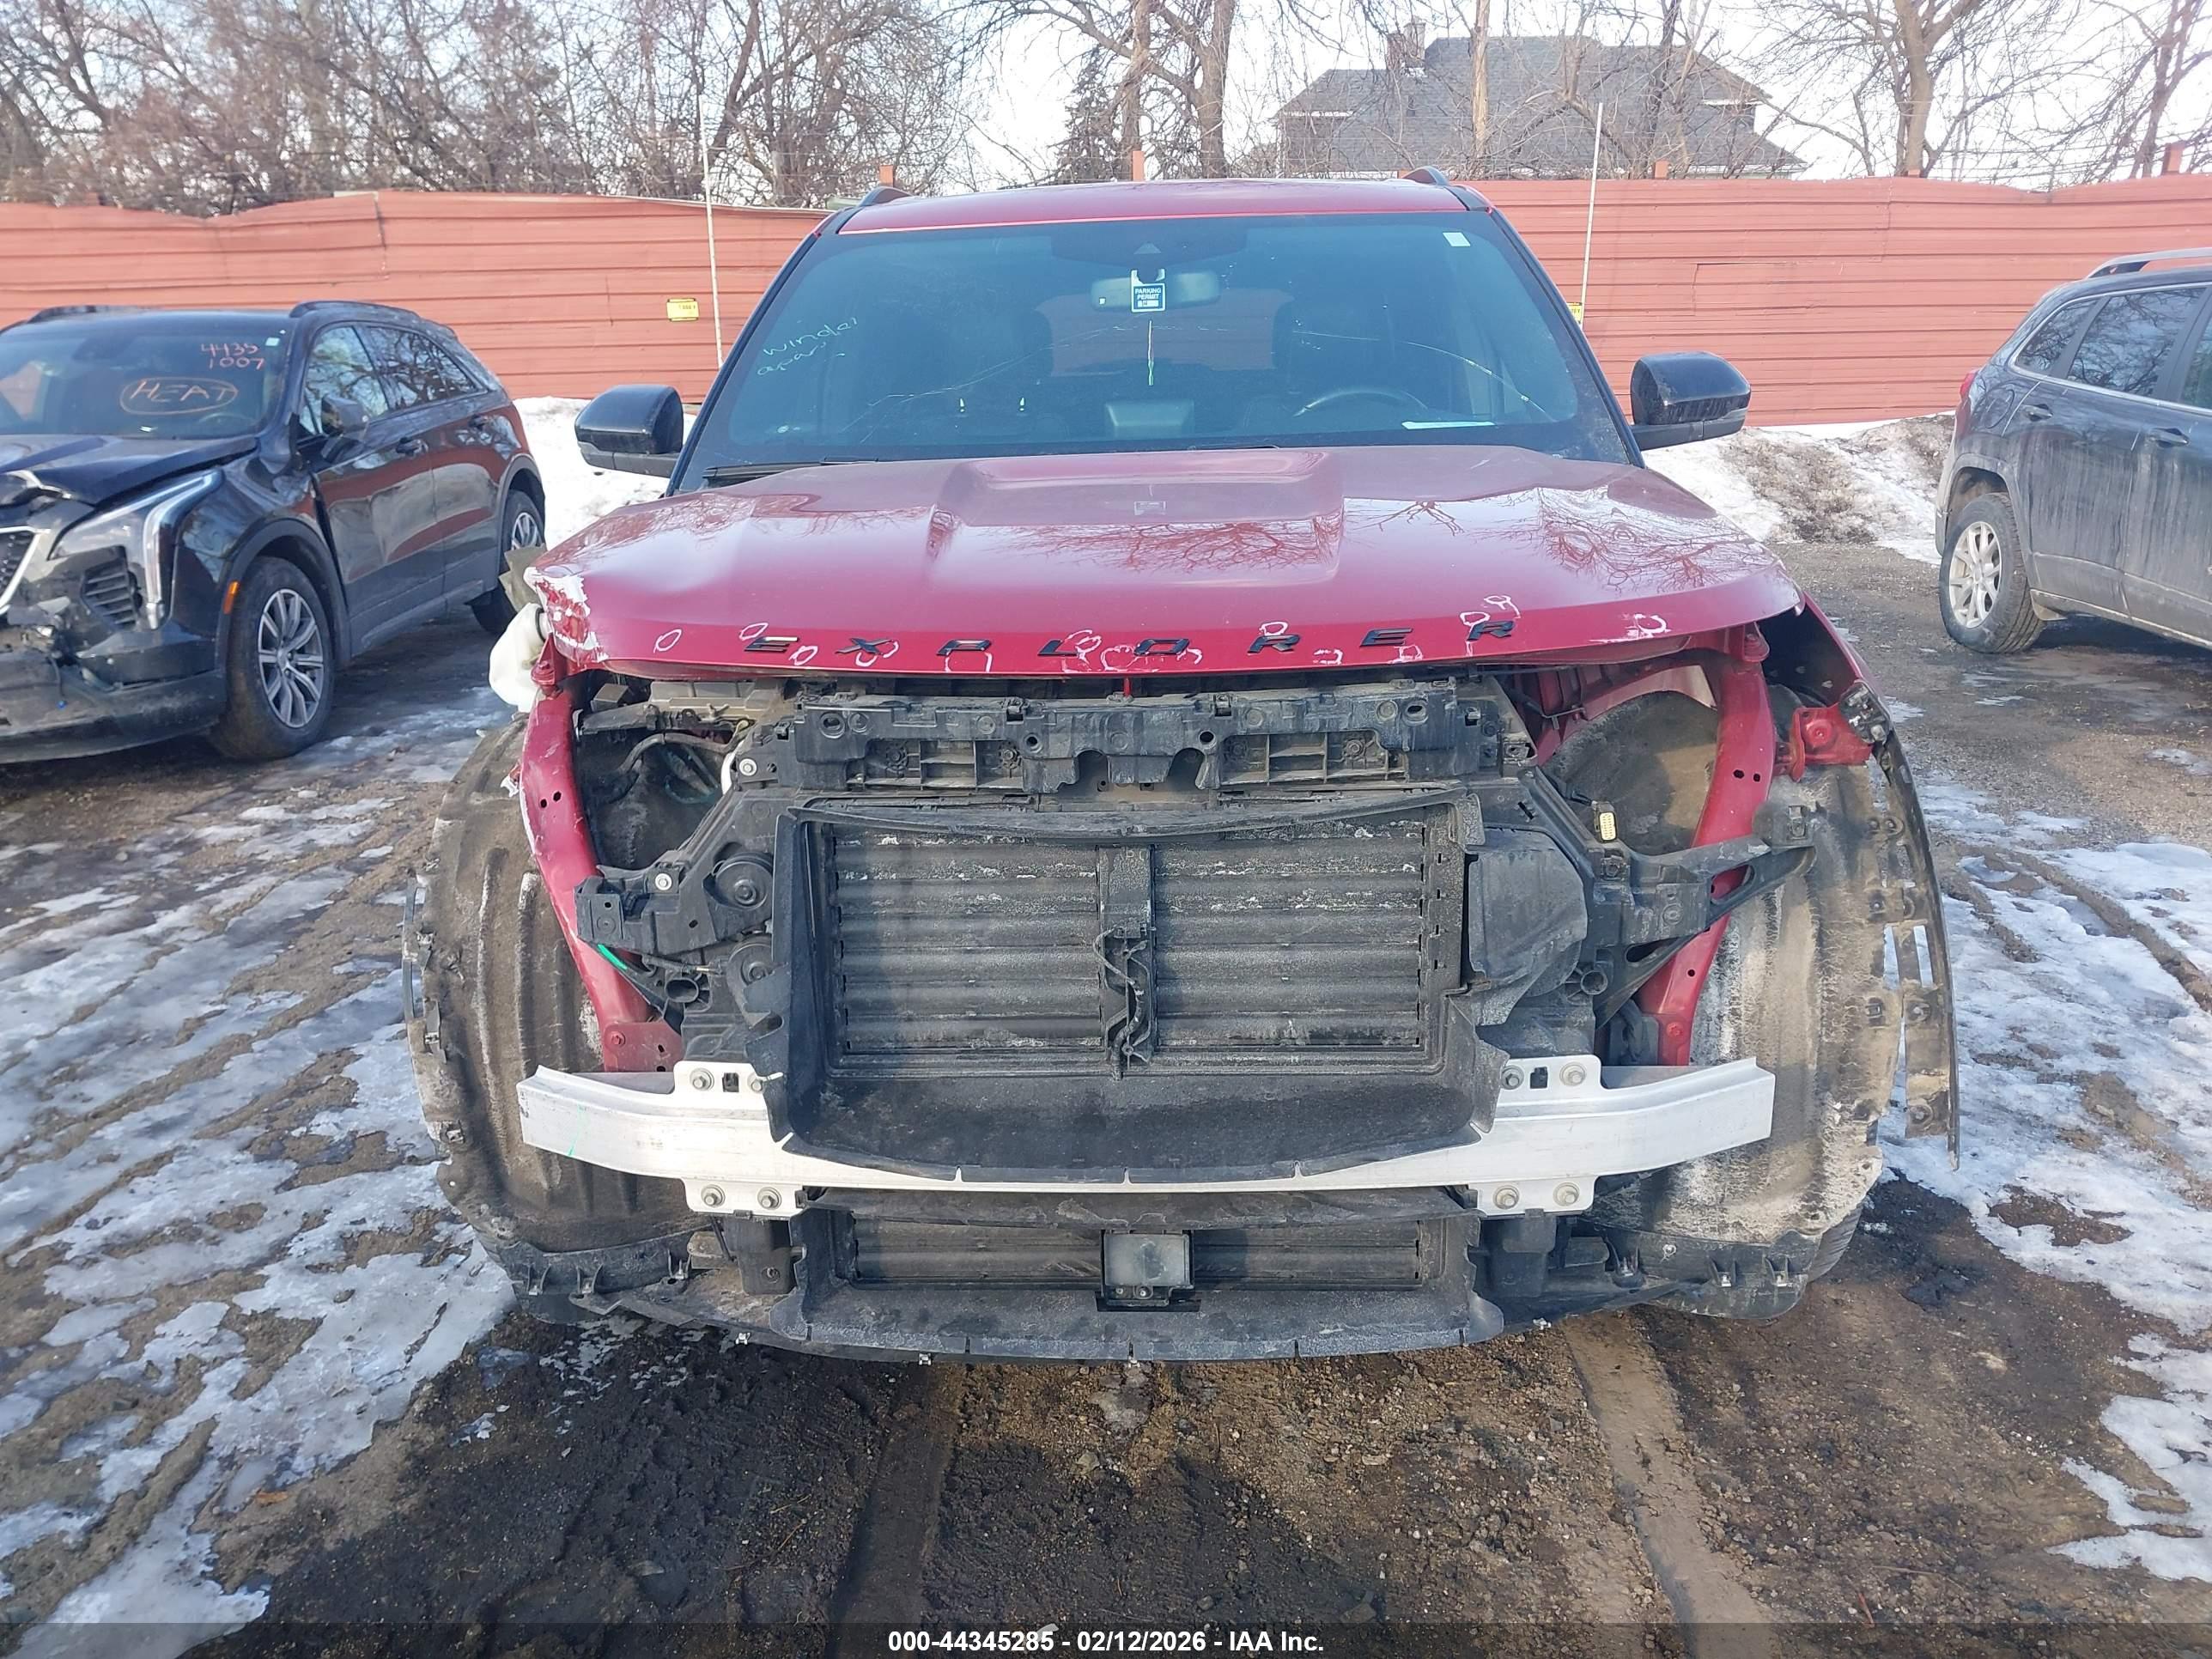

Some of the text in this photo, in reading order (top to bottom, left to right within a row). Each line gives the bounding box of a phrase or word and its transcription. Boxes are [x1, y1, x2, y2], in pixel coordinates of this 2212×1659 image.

[210, 356, 264, 370] 1007
[130, 380, 239, 403] HEAT
[744, 618, 1516, 657] EXPLORER
